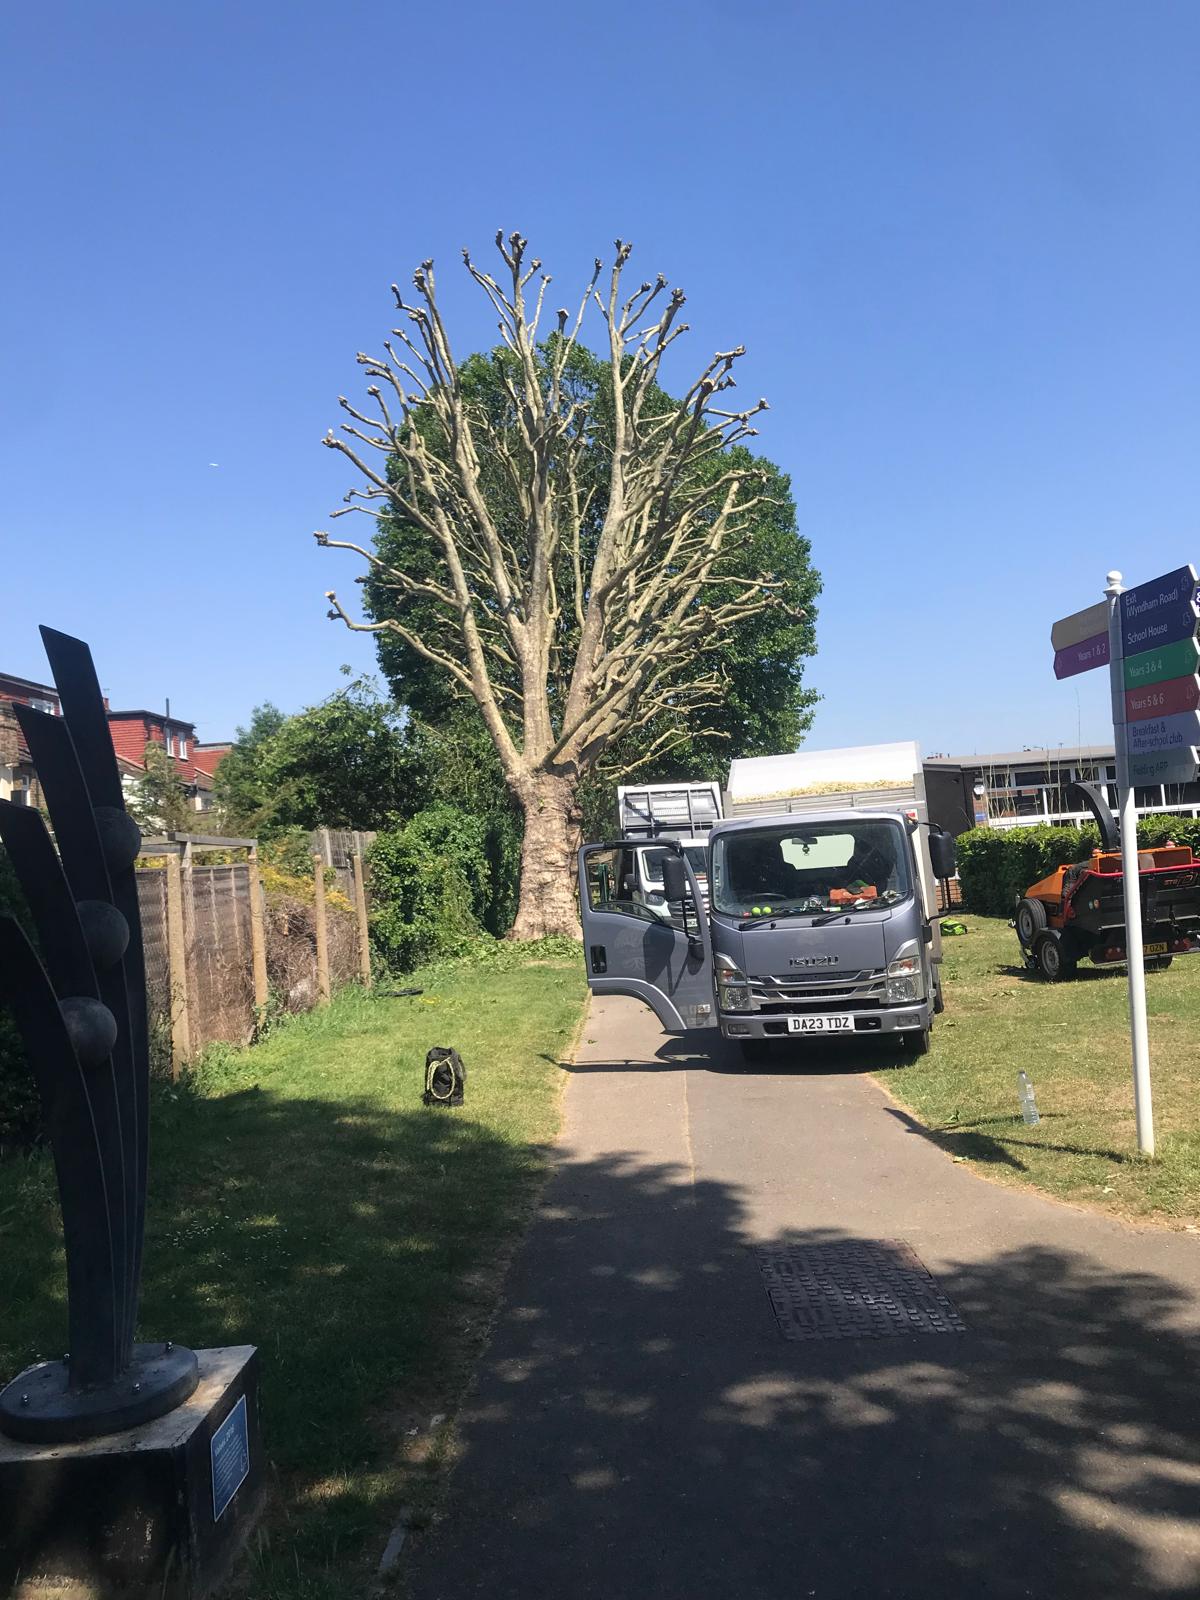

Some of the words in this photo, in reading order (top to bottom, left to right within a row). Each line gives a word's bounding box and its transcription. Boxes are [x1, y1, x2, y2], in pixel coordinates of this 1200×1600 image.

[1125, 593, 1137, 606] Exit
[1126, 599, 1158, 618] (Wyndham
[1159, 588, 1178, 605] Road)
[1127, 628, 1147, 644] School
[1148, 623, 1168, 638] House
[1096, 645, 1101, 655] &
[1129, 665, 1145, 677] Years
[1145, 662, 1150, 673] 3
[1151, 661, 1156, 672] &
[1157, 660, 1162, 670] 4
[1130, 698, 1146, 710] Years
[1147, 695, 1152, 706] 5
[1152, 694, 1158, 705] &
[1159, 693, 1165, 704] 6
[1132, 723, 1159, 737] Breakfast
[1160, 721, 1166, 733] &
[1169, 732, 1183, 745] club
[789, 955, 839, 968] ISUZU
[793, 1018, 824, 1030] DA23
[826, 1016, 850, 1029] TDZ
